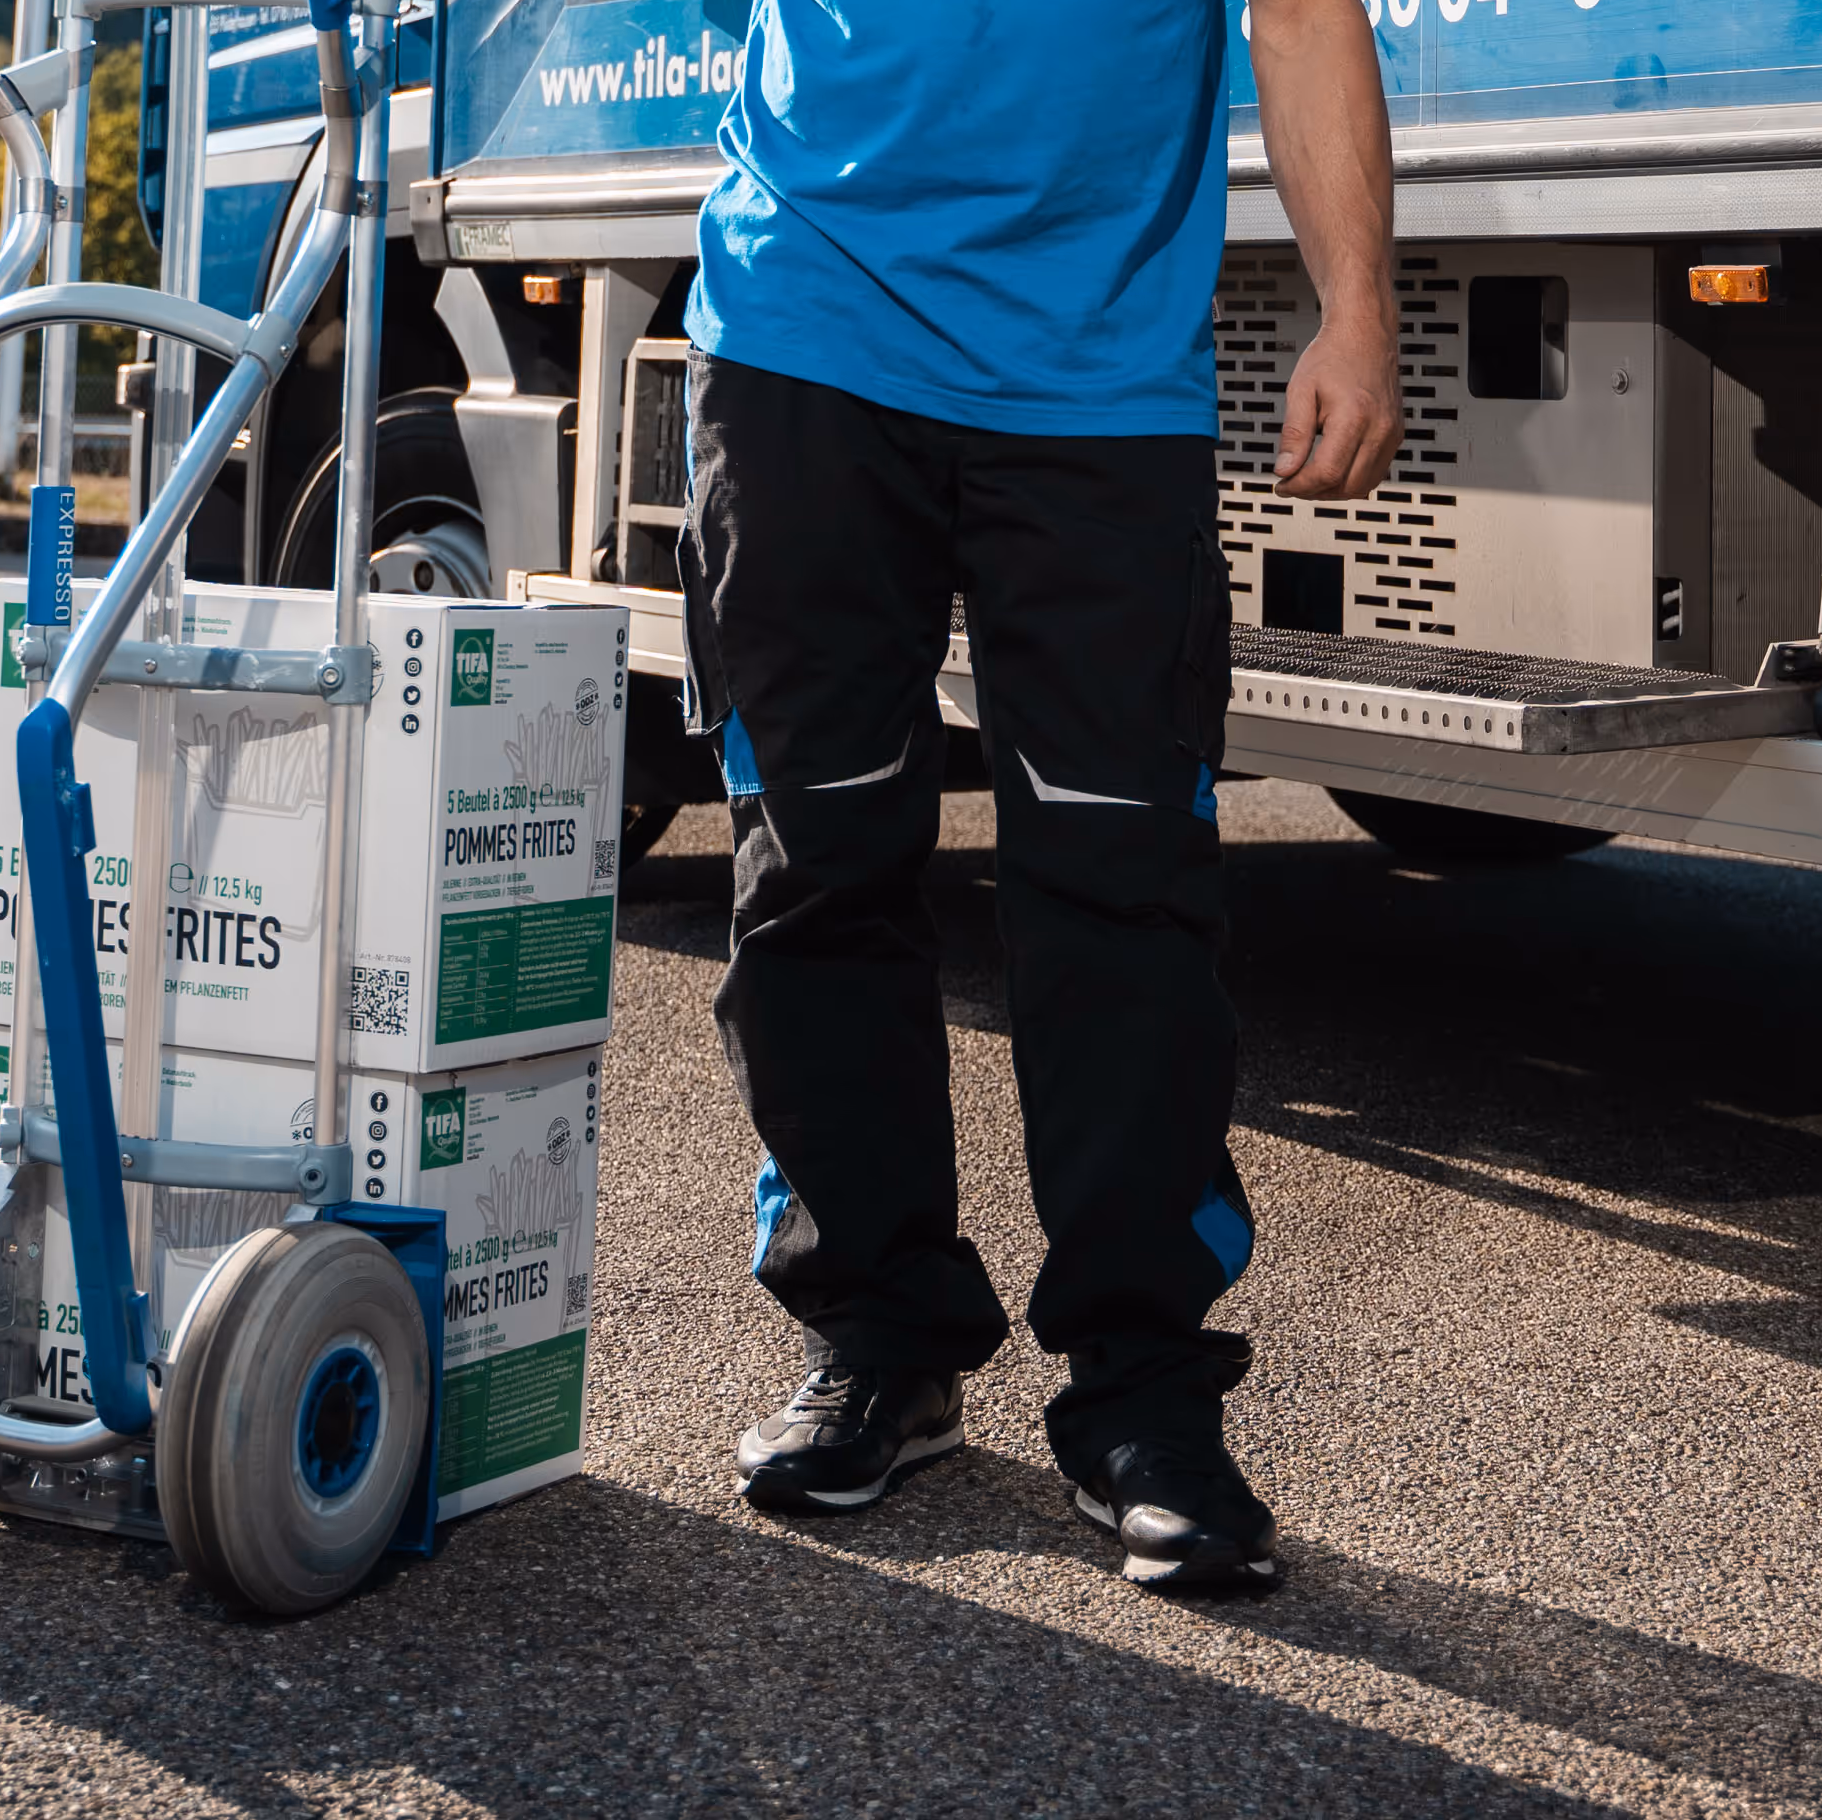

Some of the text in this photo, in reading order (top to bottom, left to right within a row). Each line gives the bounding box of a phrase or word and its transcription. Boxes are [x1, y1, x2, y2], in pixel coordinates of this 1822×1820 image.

[54, 492, 76, 621] EXPRESSO
[456, 652, 489, 673] TIFA
[447, 789, 455, 814] 5
[457, 787, 491, 814] Beutel
[493, 786, 500, 812] à
[502, 784, 527, 810] 2500
[530, 790, 537, 814] g
[444, 818, 576, 867] POMMES FRITES
[93, 855, 132, 887] 250
[213, 876, 241, 899] 12,5
[245, 879, 263, 906] kg
[180, 979, 250, 1002] PFLANZENFETT
[425, 1111, 461, 1137] TIFA
[474, 1236, 500, 1265] 2500
[502, 1239, 509, 1263] g
[444, 1259, 549, 1323] MMES FRITES
